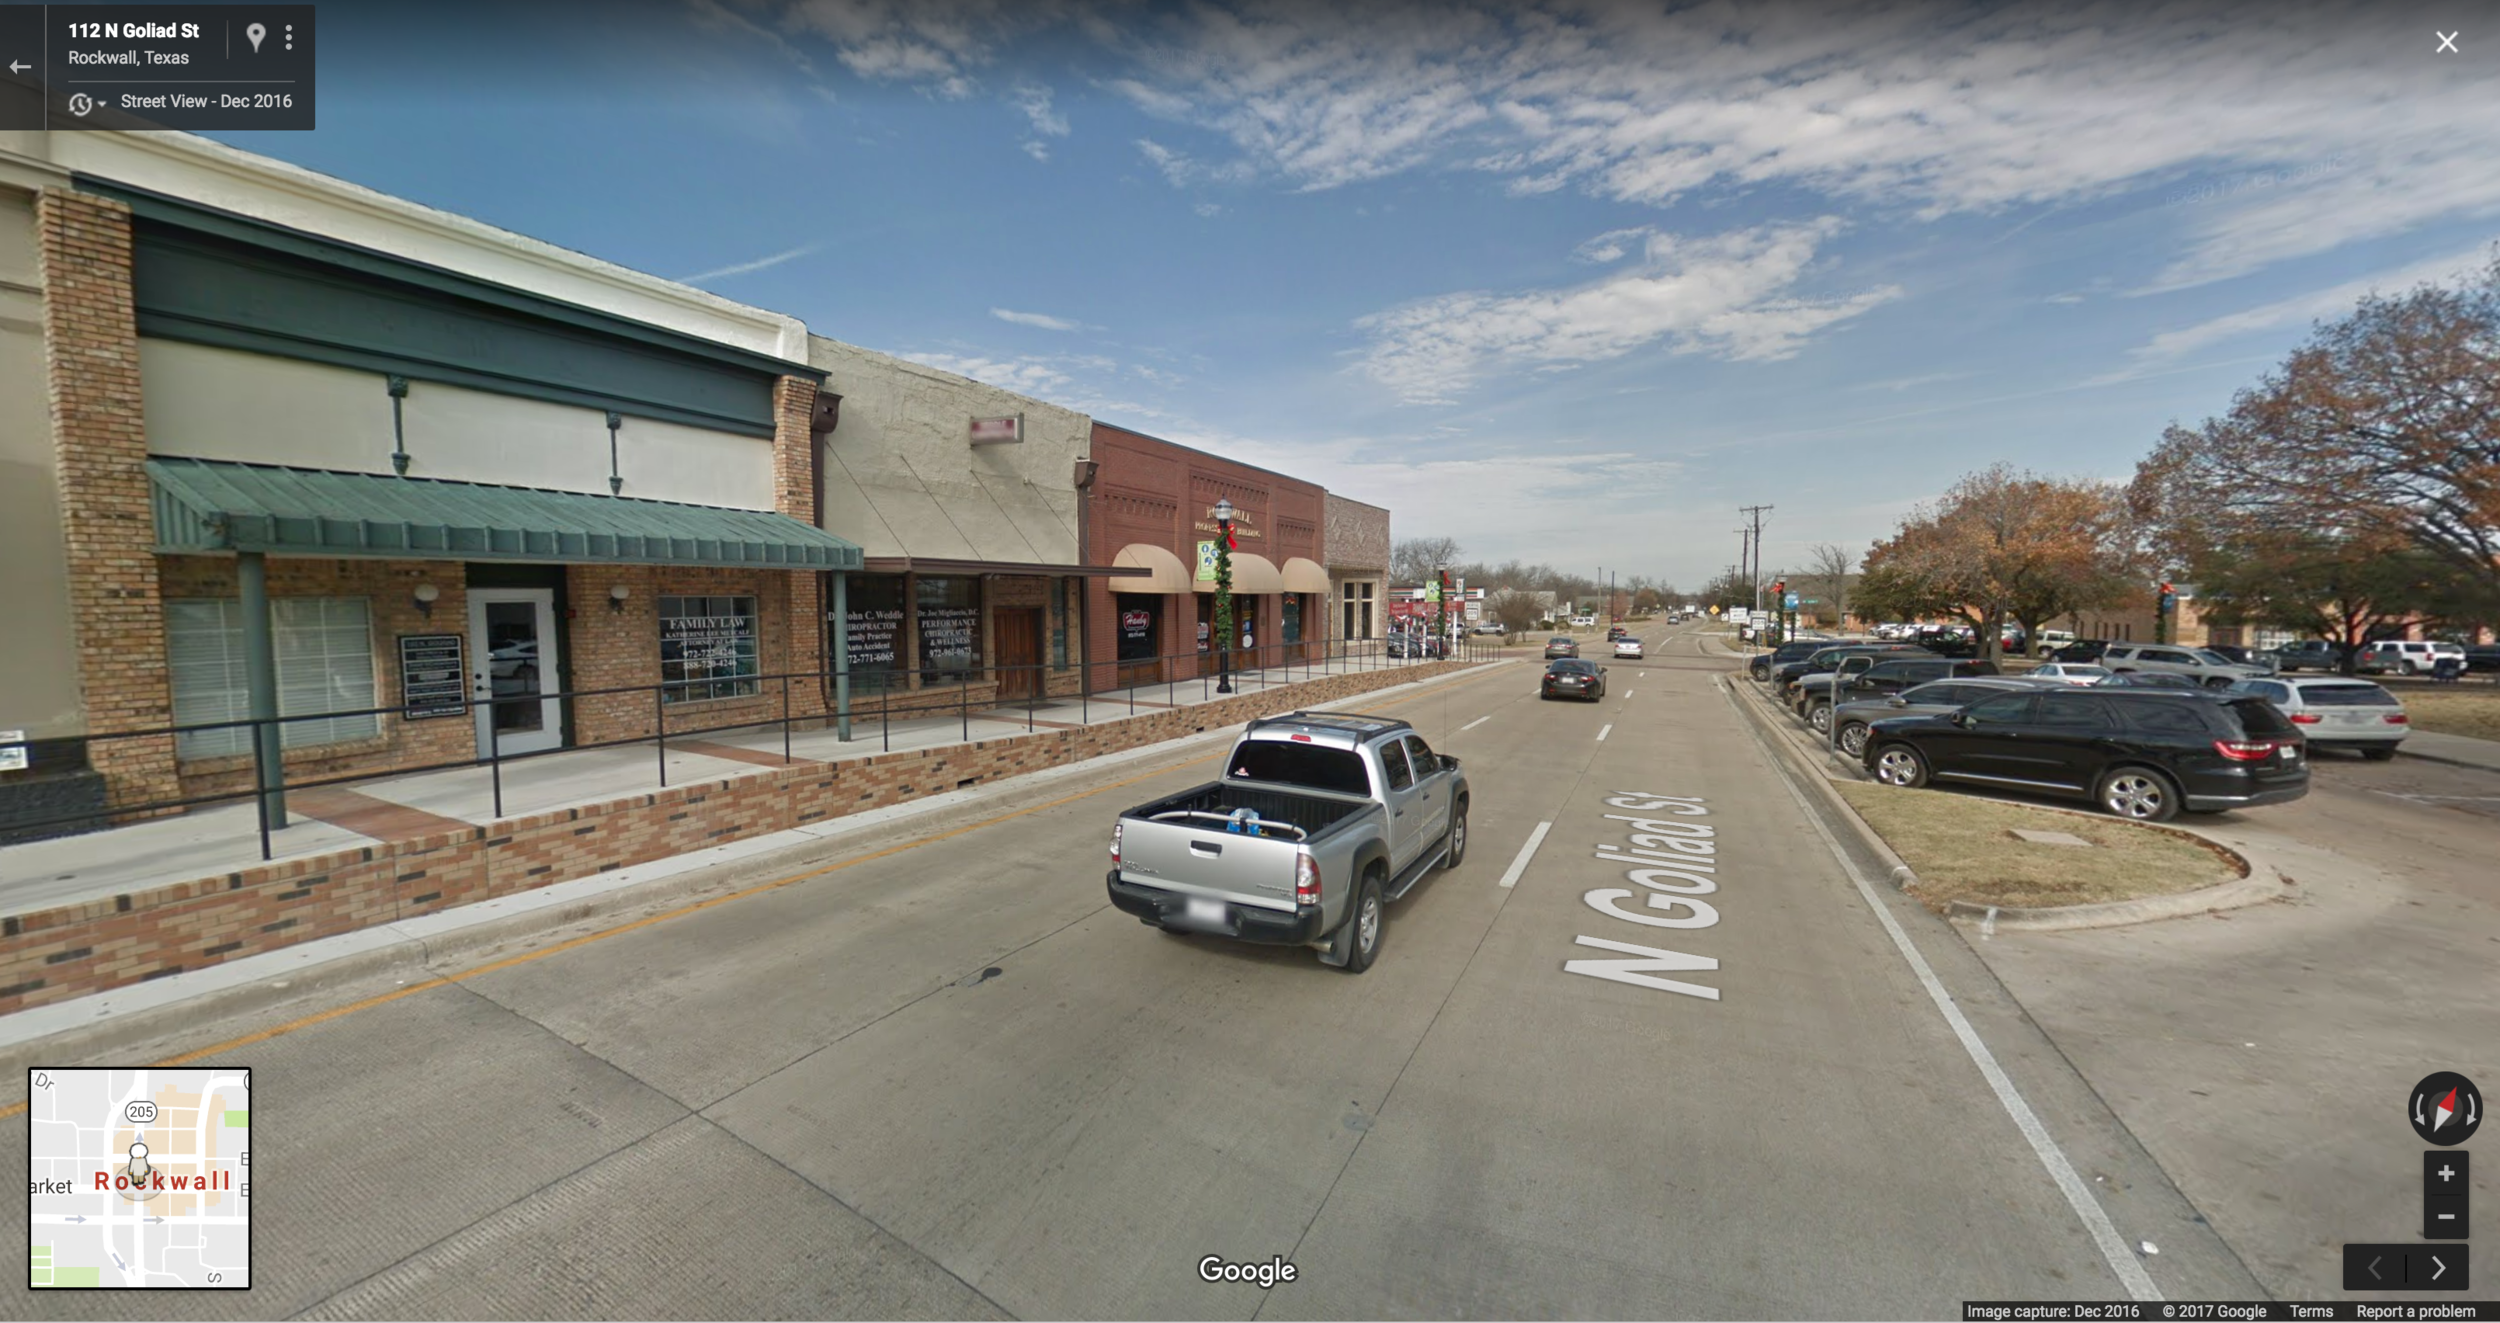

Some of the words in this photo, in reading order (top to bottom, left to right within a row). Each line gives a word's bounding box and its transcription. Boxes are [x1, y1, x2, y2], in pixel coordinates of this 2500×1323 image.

[1206, 507, 1253, 524] ROWALL
[845, 610, 863, 621] ohn
[875, 610, 904, 620] Weddle
[670, 618, 717, 630] FAMILY
[720, 617, 746, 629] LAW
[846, 622, 898, 632] IROPRACTOR
[921, 618, 977, 628] PERFORMANCE
[848, 633, 866, 642] amily
[867, 632, 893, 641] Practice
[924, 628, 973, 638] CHIROPRACTIC
[864, 642, 891, 650] Accident
[936, 637, 971, 646] WELLNESS
[847, 651, 895, 665] 72-771-6065
